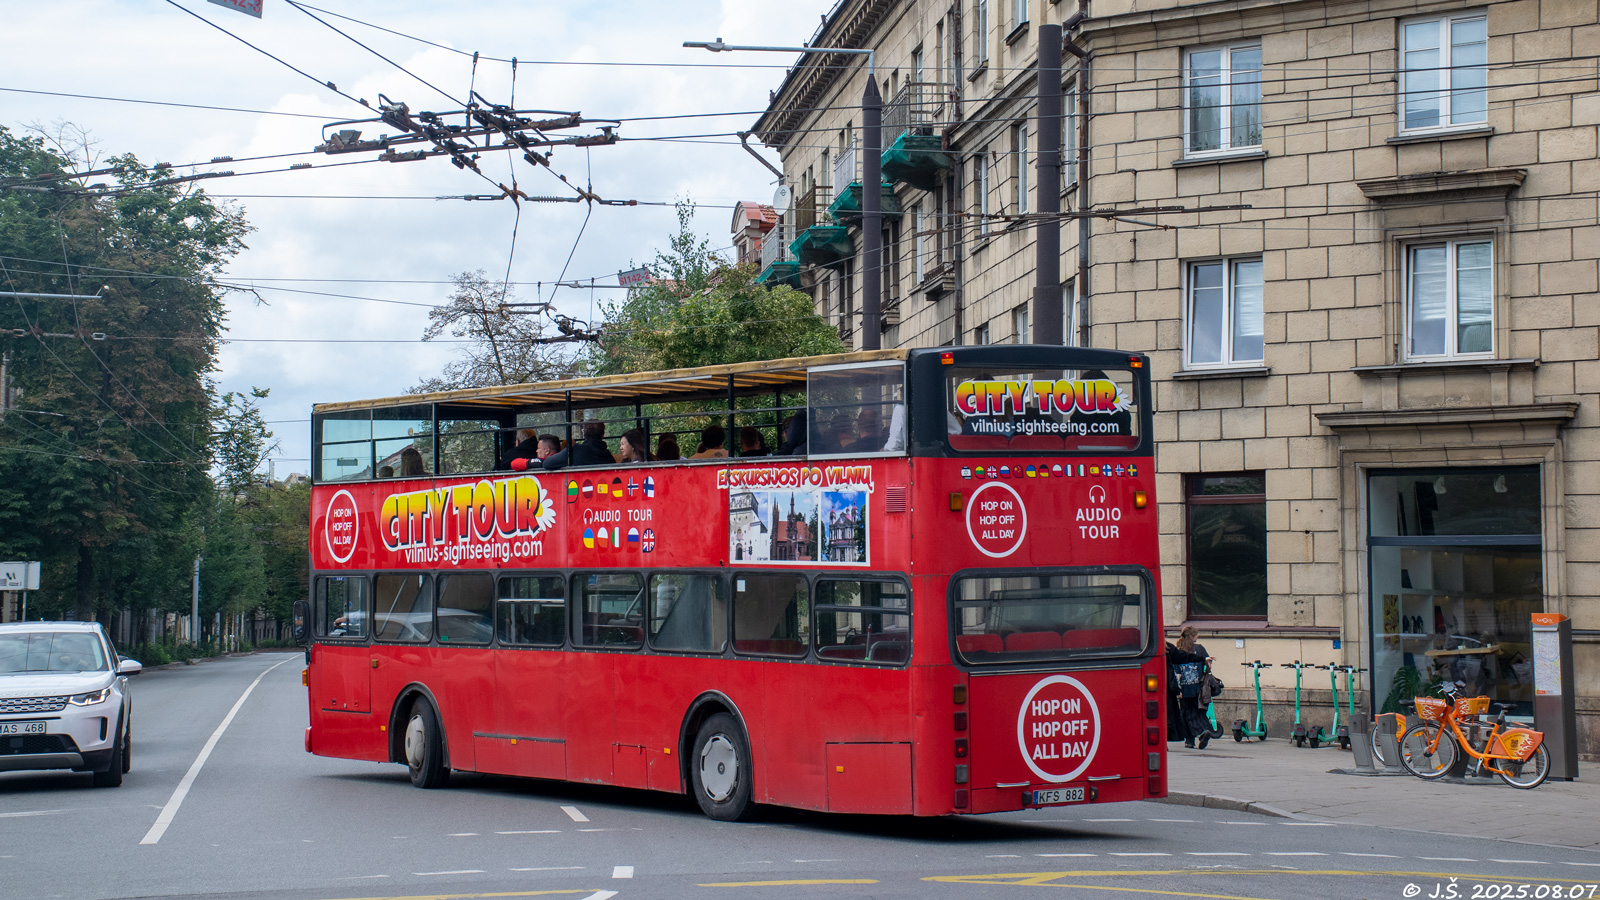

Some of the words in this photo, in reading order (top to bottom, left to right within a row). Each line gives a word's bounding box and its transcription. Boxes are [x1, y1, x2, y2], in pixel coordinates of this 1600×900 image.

[956, 380, 1031, 416] CITY
[1032, 379, 1119, 415] TOUR
[971, 419, 1120, 436] vilnius-sightseeing.com
[718, 467, 798, 488] EKSKURSIJOS
[801, 467, 822, 486] PO
[333, 509, 344, 517] HOP
[344, 508, 352, 517] ON
[981, 501, 998, 510] HOP
[1000, 501, 1013, 510] ON
[381, 487, 451, 551] CITY
[453, 475, 542, 542] TOUR
[594, 510, 621, 522] AUDIO
[627, 509, 653, 521] TOUR
[980, 516, 997, 525] HOP
[999, 515, 1015, 524] OFF
[1076, 507, 1121, 521] AUDIO
[333, 523, 343, 531] HOP
[343, 522, 352, 531] OFF
[1079, 525, 1120, 539] TOUR
[333, 536, 343, 545] ALL
[343, 535, 352, 544] DAY
[982, 530, 998, 539] ALL
[999, 529, 1015, 539] DAY
[405, 538, 543, 565] vilnius-sightseeing.com
[1032, 699, 1060, 716] HOP
[1061, 698, 1081, 715] ON
[25, 723, 44, 732] 468
[1032, 720, 1061, 738] HOP
[1062, 719, 1089, 736] OFF
[1032, 743, 1060, 760] ALL
[1062, 741, 1089, 758] DAY
[1038, 791, 1060, 803] KFS
[1065, 789, 1083, 800] 882
